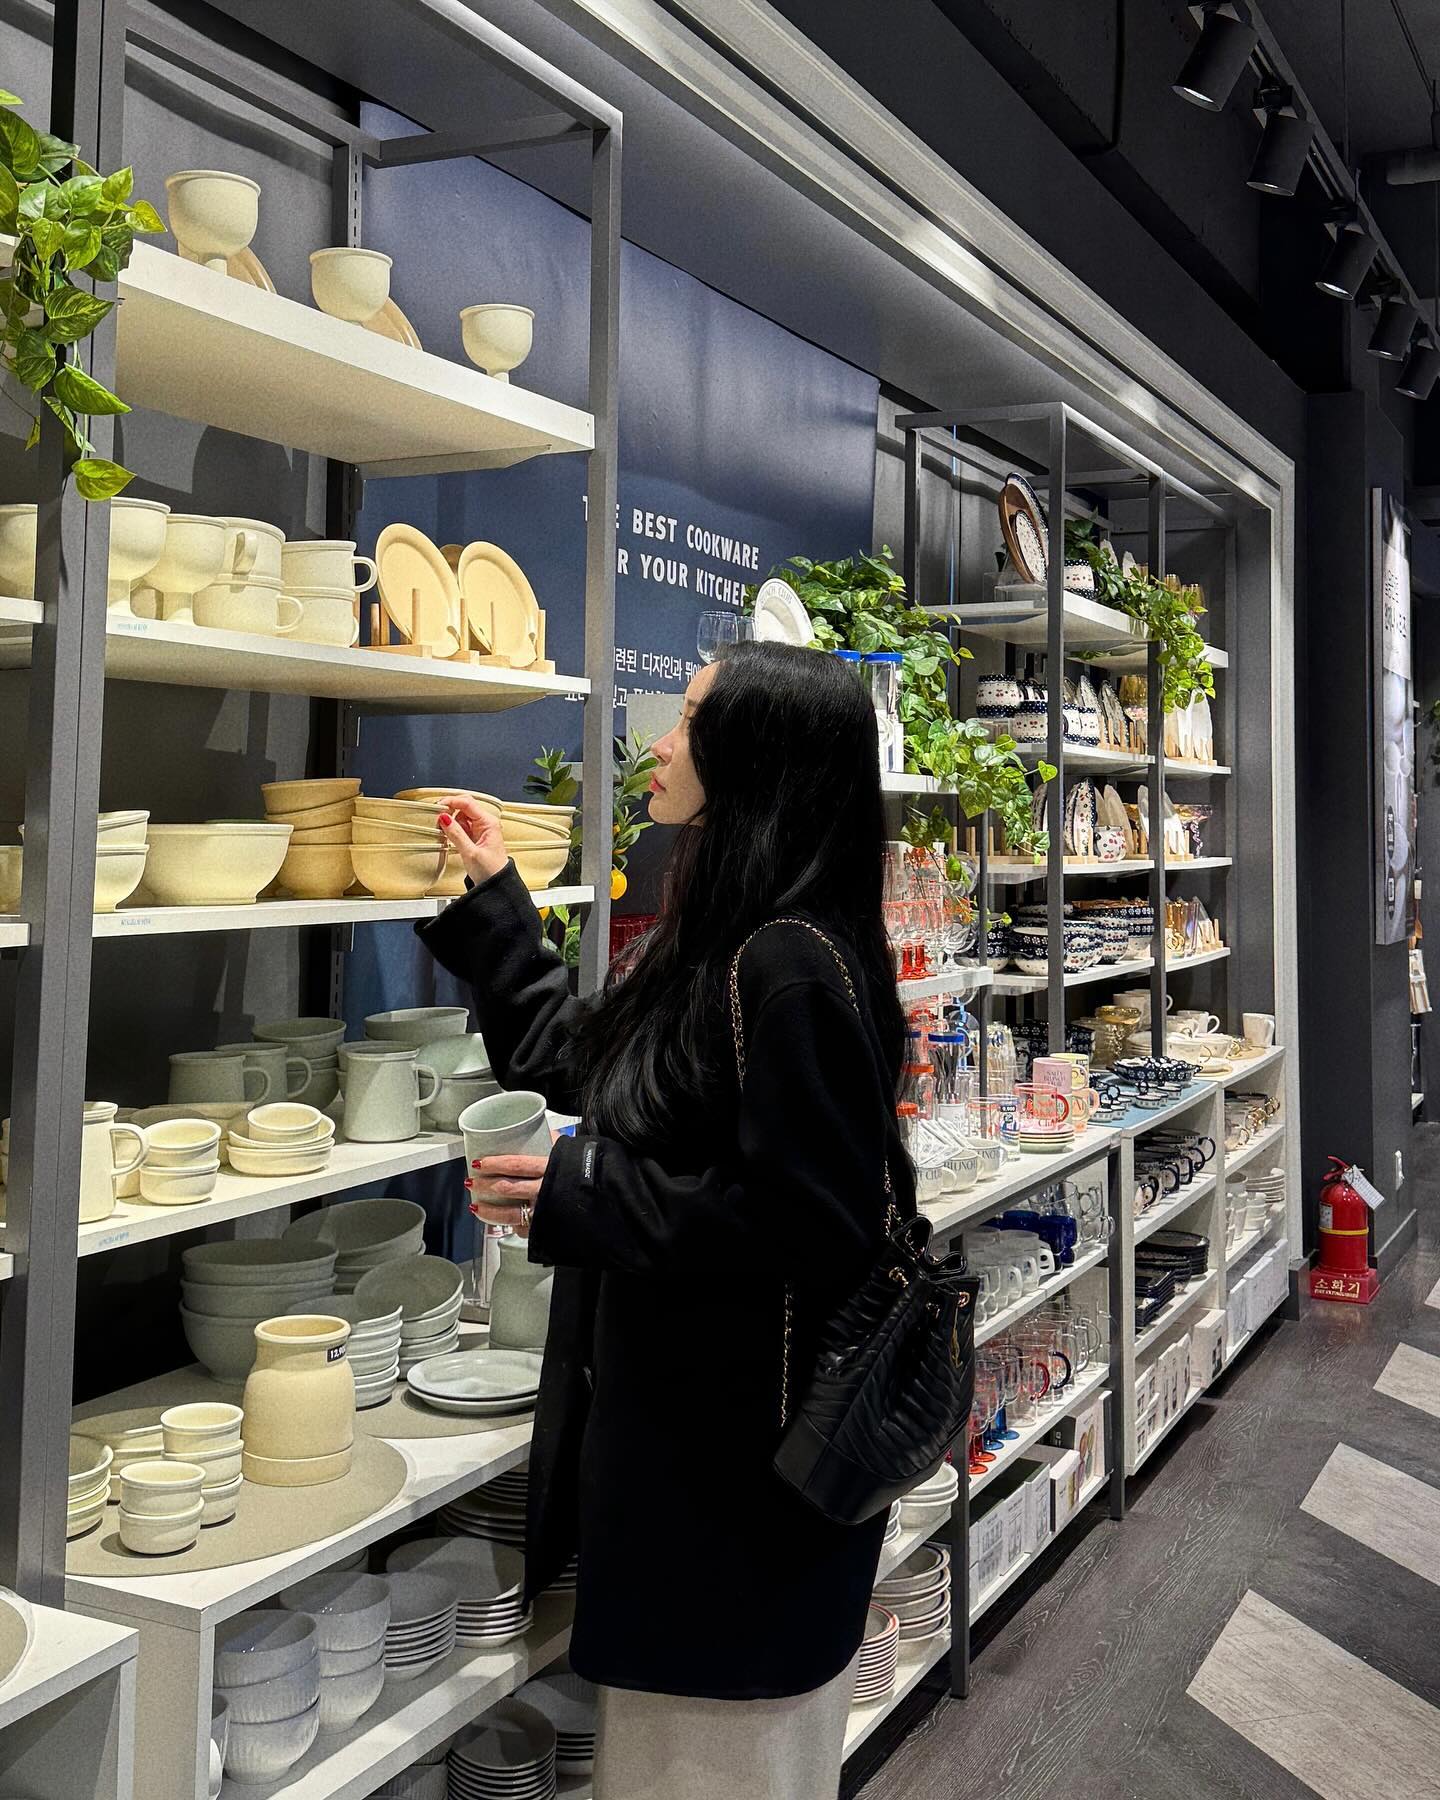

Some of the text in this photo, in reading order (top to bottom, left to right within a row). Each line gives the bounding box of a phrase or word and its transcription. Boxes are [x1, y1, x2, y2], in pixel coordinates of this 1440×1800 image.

[632, 508, 678, 543] BEST
[686, 524, 760, 570] COOKWARE
[640, 553, 688, 588] YOUR
[614, 646, 636, 672] 련된
[642, 652, 682, 681] 디자인과
[1314, 1278, 1360, 1295] 소화기
